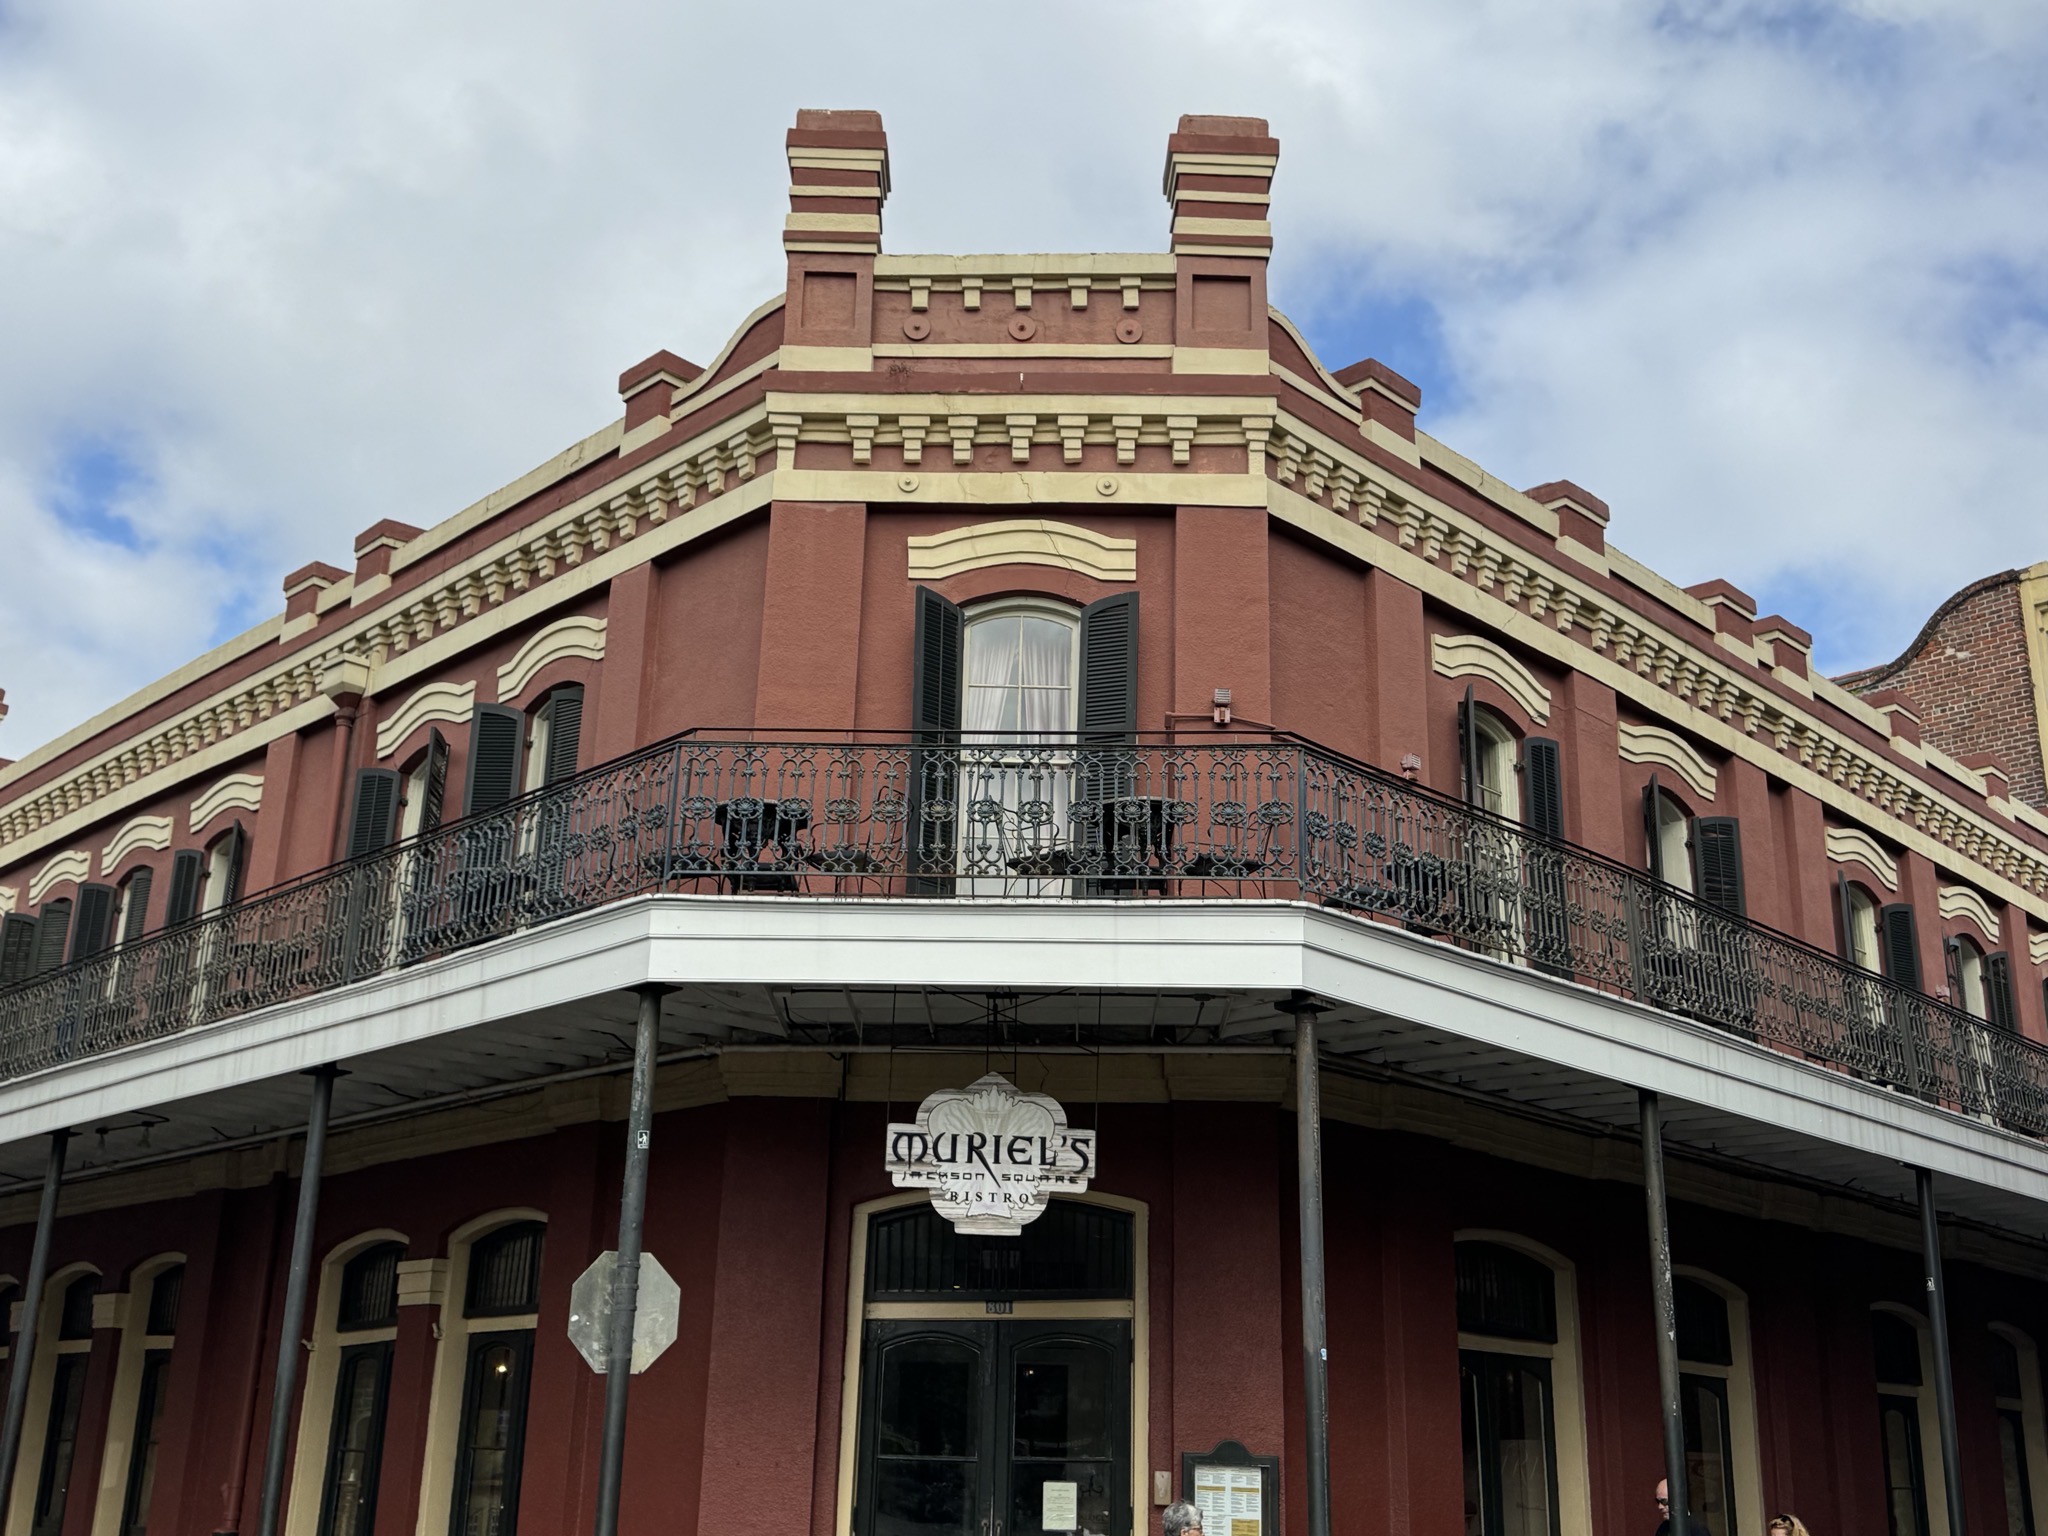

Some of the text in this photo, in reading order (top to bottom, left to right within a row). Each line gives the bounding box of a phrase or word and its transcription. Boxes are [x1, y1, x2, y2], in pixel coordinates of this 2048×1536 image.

[892, 1132, 1090, 1188] MURIEL'S
[901, 1171, 1080, 1184] JACKSON SQUARE
[950, 1191, 1029, 1203] BISTRO
[987, 1301, 1011, 1314] 801
